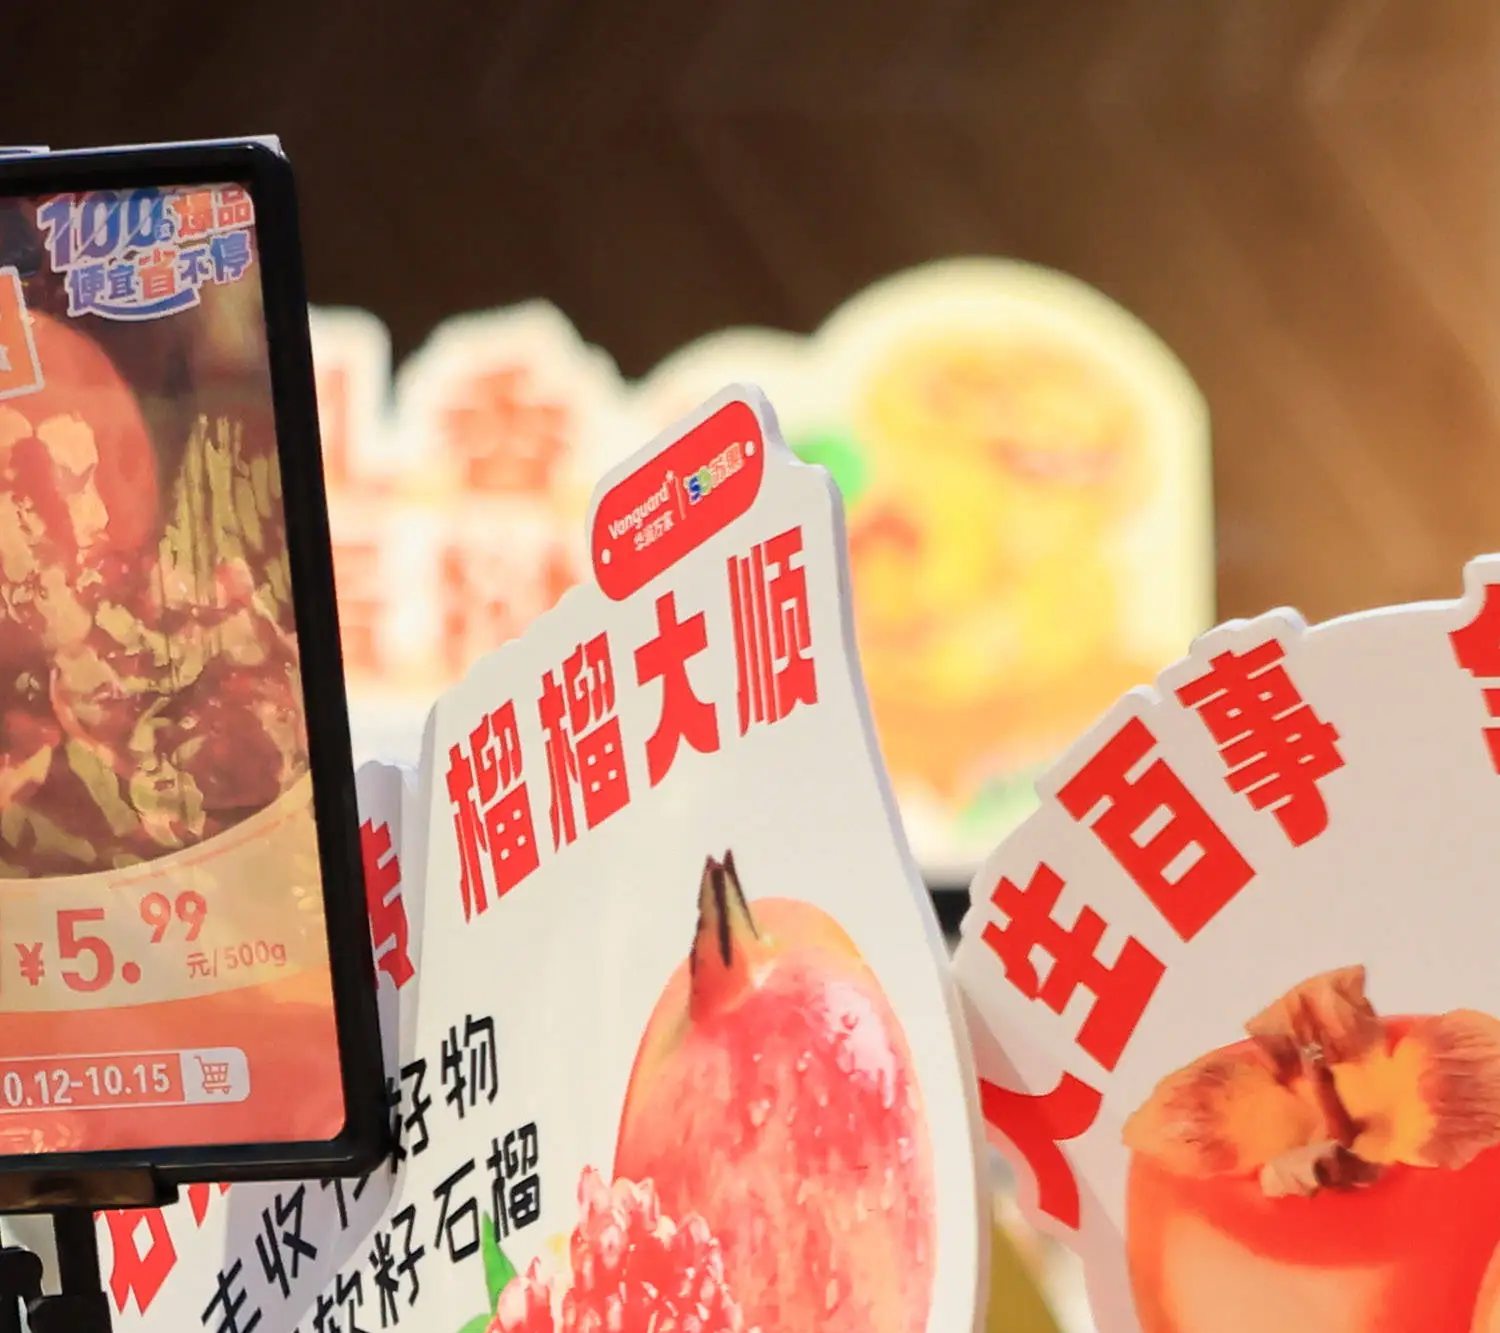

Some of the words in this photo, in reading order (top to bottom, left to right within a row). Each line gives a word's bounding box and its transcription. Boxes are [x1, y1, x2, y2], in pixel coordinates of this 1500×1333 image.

[70, 233, 250, 309] 便宜省不停
[607, 480, 669, 540] Vanguard
[445, 525, 816, 925] 榴榴大顺
